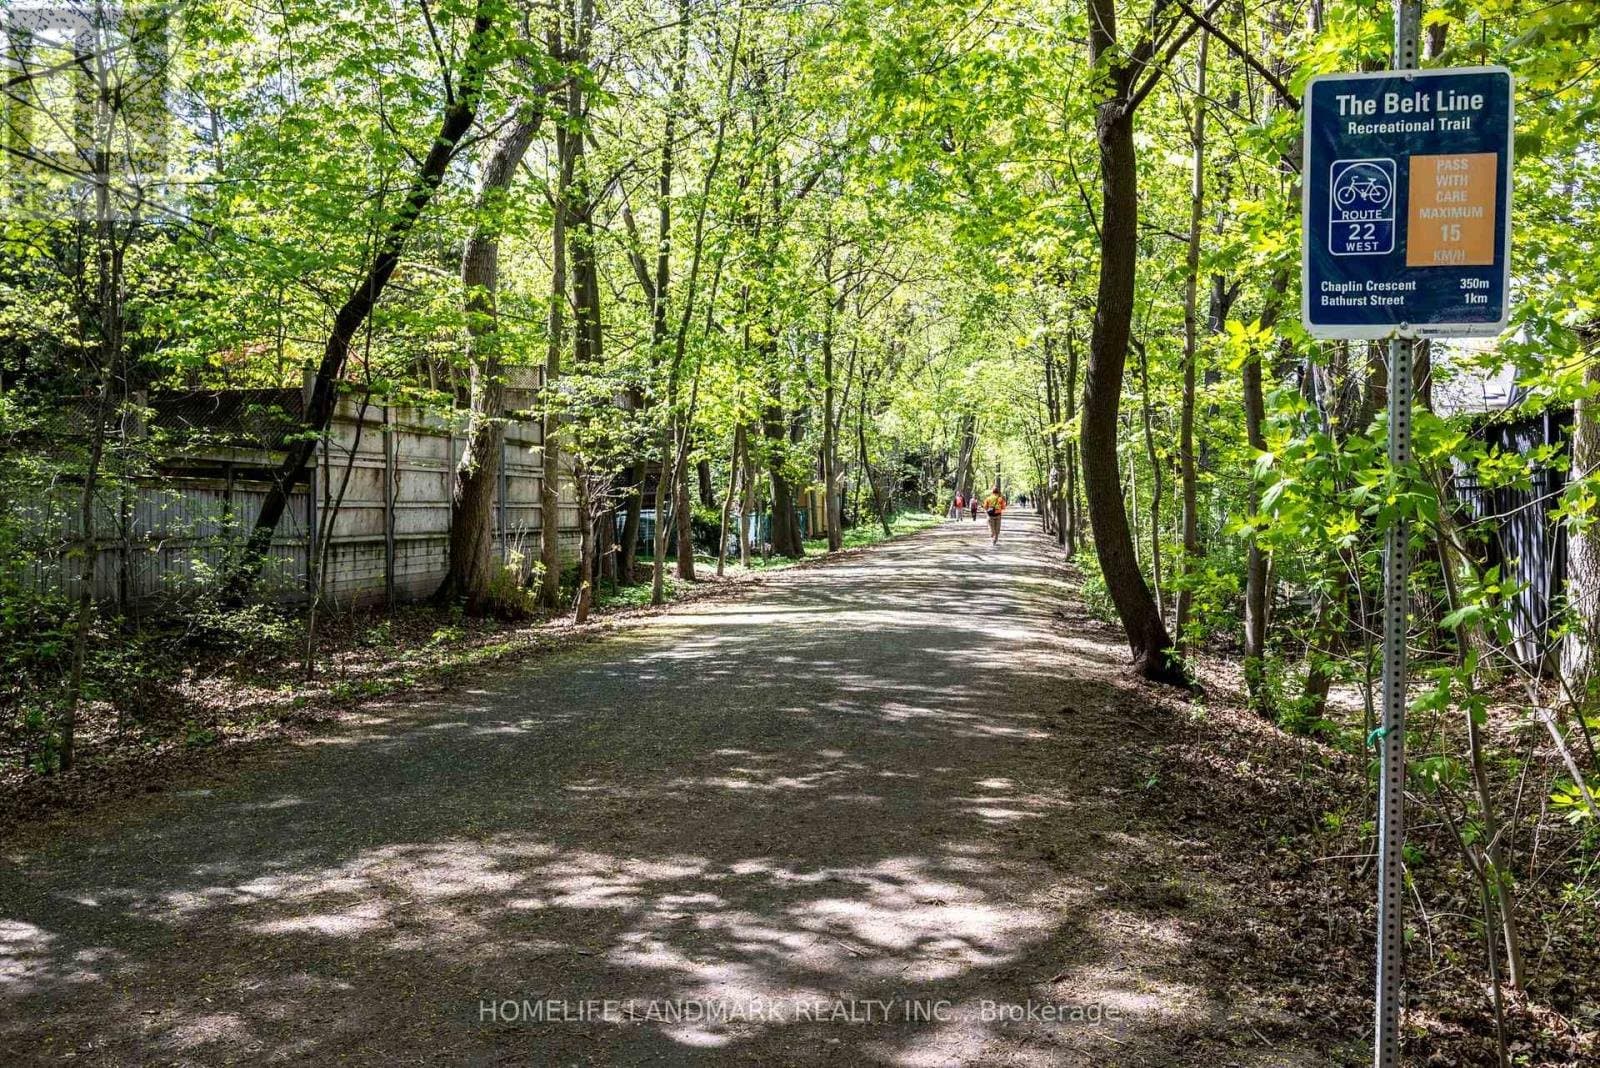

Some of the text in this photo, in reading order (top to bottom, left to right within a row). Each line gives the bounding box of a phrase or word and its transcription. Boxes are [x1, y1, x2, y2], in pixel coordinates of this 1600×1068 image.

[1336, 90, 1484, 116] The Belt Line
[1348, 118, 1471, 135] Recreational Trail
[1437, 159, 1469, 170] PASS
[1436, 175, 1468, 186] WITH
[1436, 190, 1468, 202] CARE
[1341, 210, 1382, 220] ROUTE
[1419, 206, 1483, 218] MAXIMUM
[1348, 223, 1376, 240] 22
[1441, 224, 1461, 242] 15
[1345, 241, 1379, 251] WEST
[1433, 249, 1466, 261] KM/H
[1320, 278, 1489, 294] Chaplin Crescent 350m
[1320, 293, 1488, 306] Bathurst Street 1km
